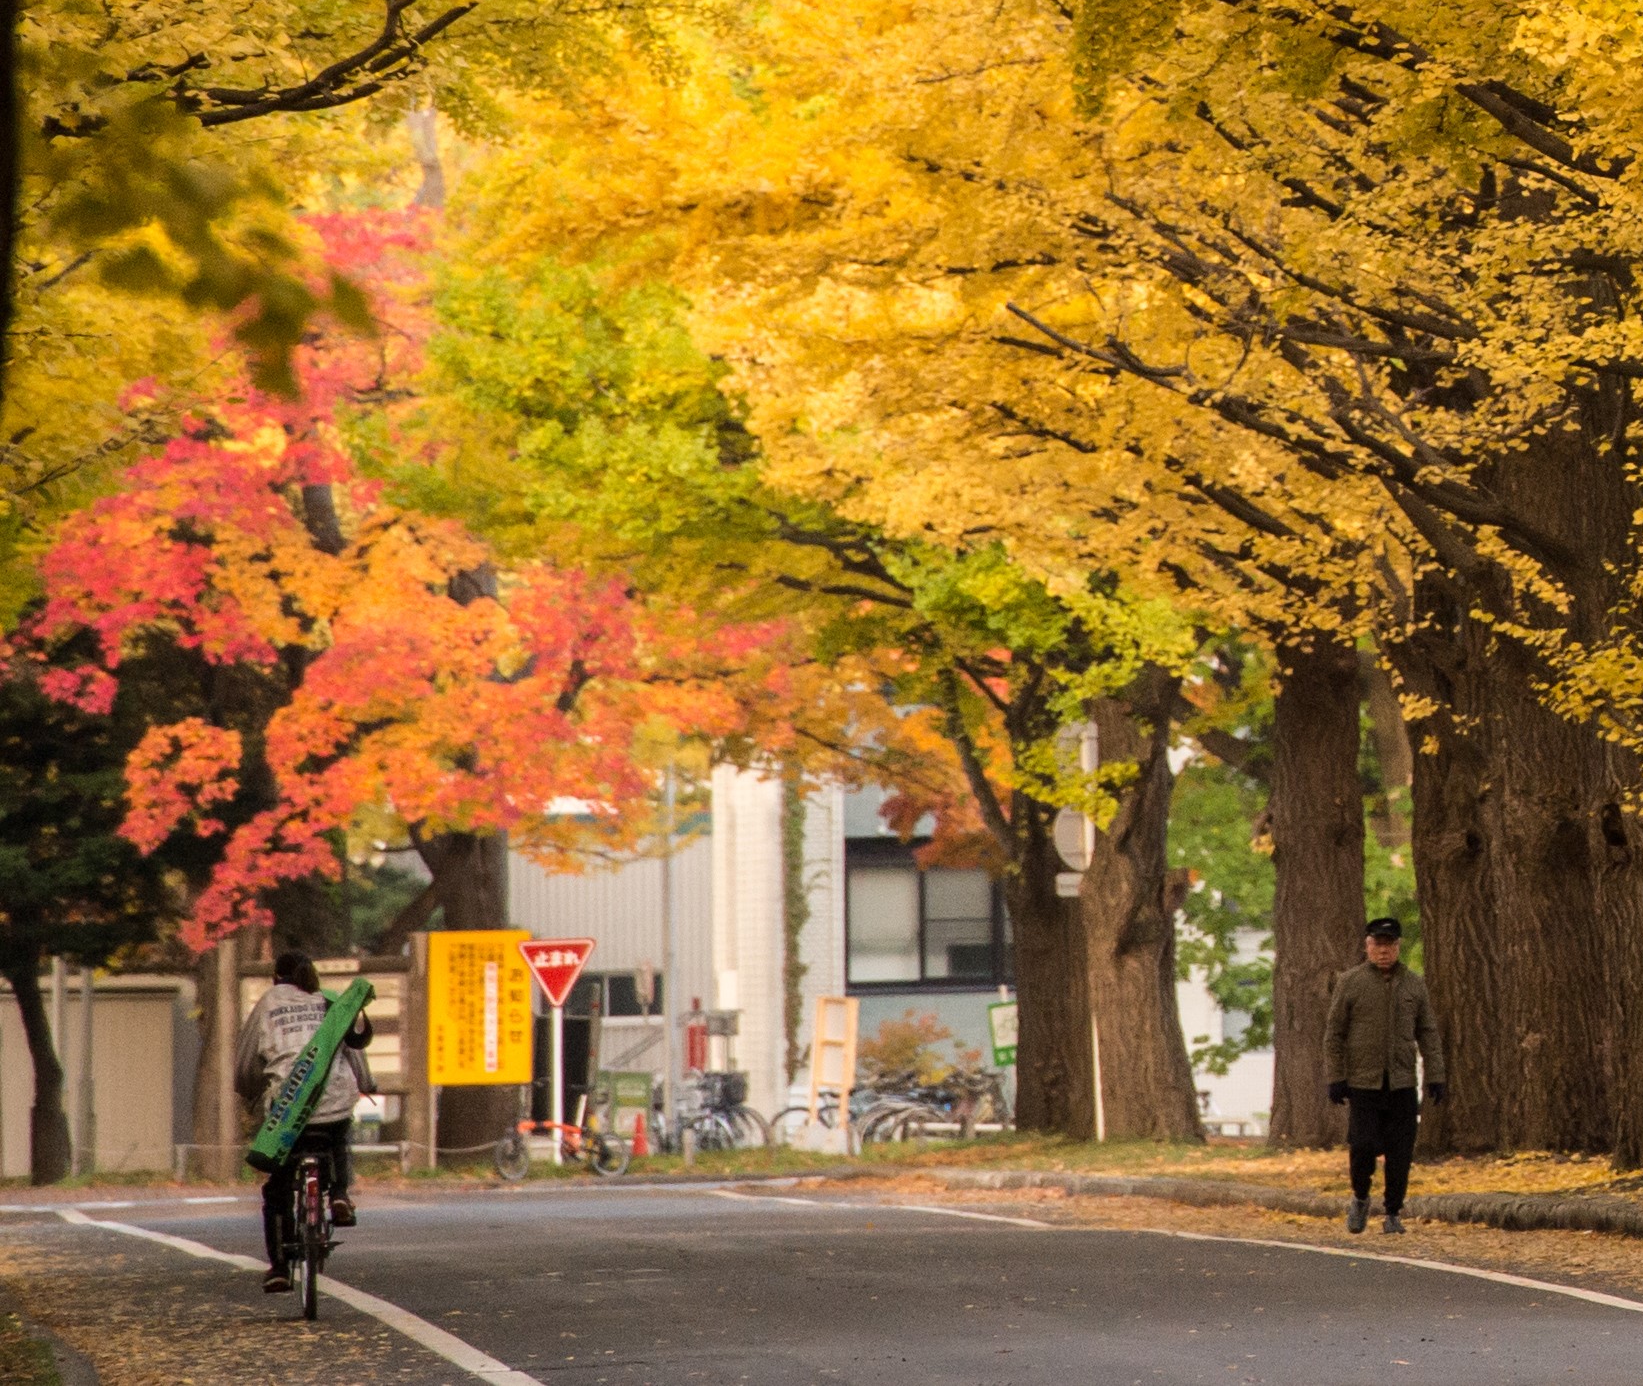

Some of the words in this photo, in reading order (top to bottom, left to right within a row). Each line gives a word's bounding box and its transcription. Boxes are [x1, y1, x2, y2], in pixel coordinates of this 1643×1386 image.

[533, 949, 583, 968] 止まれ
[509, 967, 524, 1044] お知らせ
